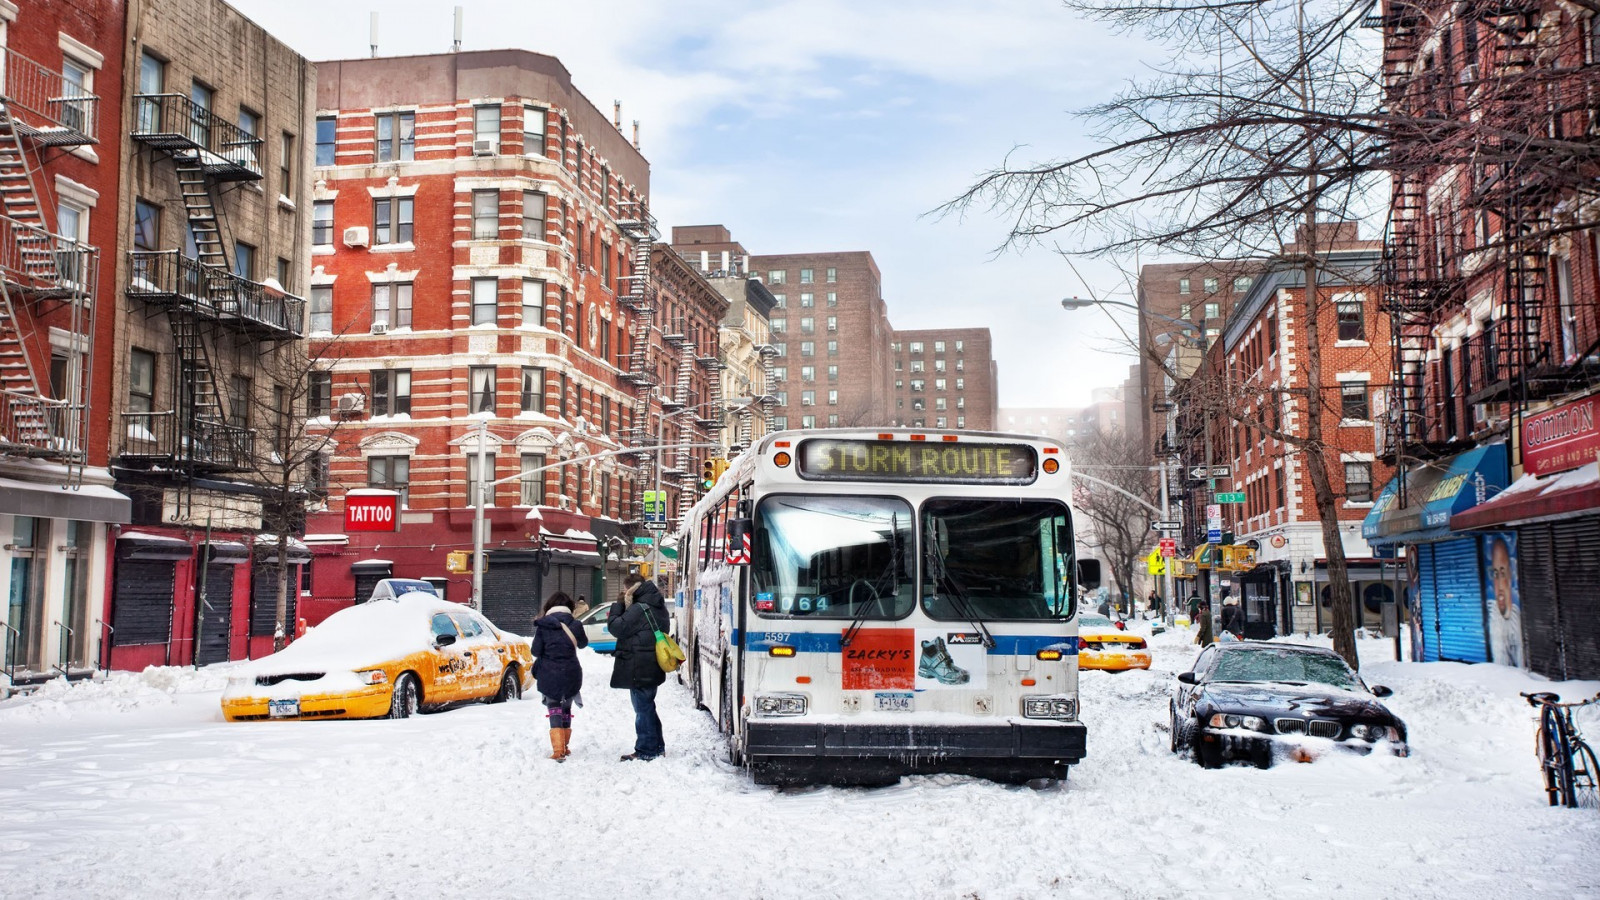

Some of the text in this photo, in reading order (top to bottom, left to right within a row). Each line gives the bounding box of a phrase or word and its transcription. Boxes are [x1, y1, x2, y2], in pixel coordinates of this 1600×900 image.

[817, 443, 1012, 475] STORM ROUTE
[1552, 454, 1564, 467] BAR
[1567, 450, 1581, 462] AND
[350, 505, 392, 522] TATTOO
[764, 632, 791, 642] 5597
[847, 649, 911, 661] ZACKY'S
